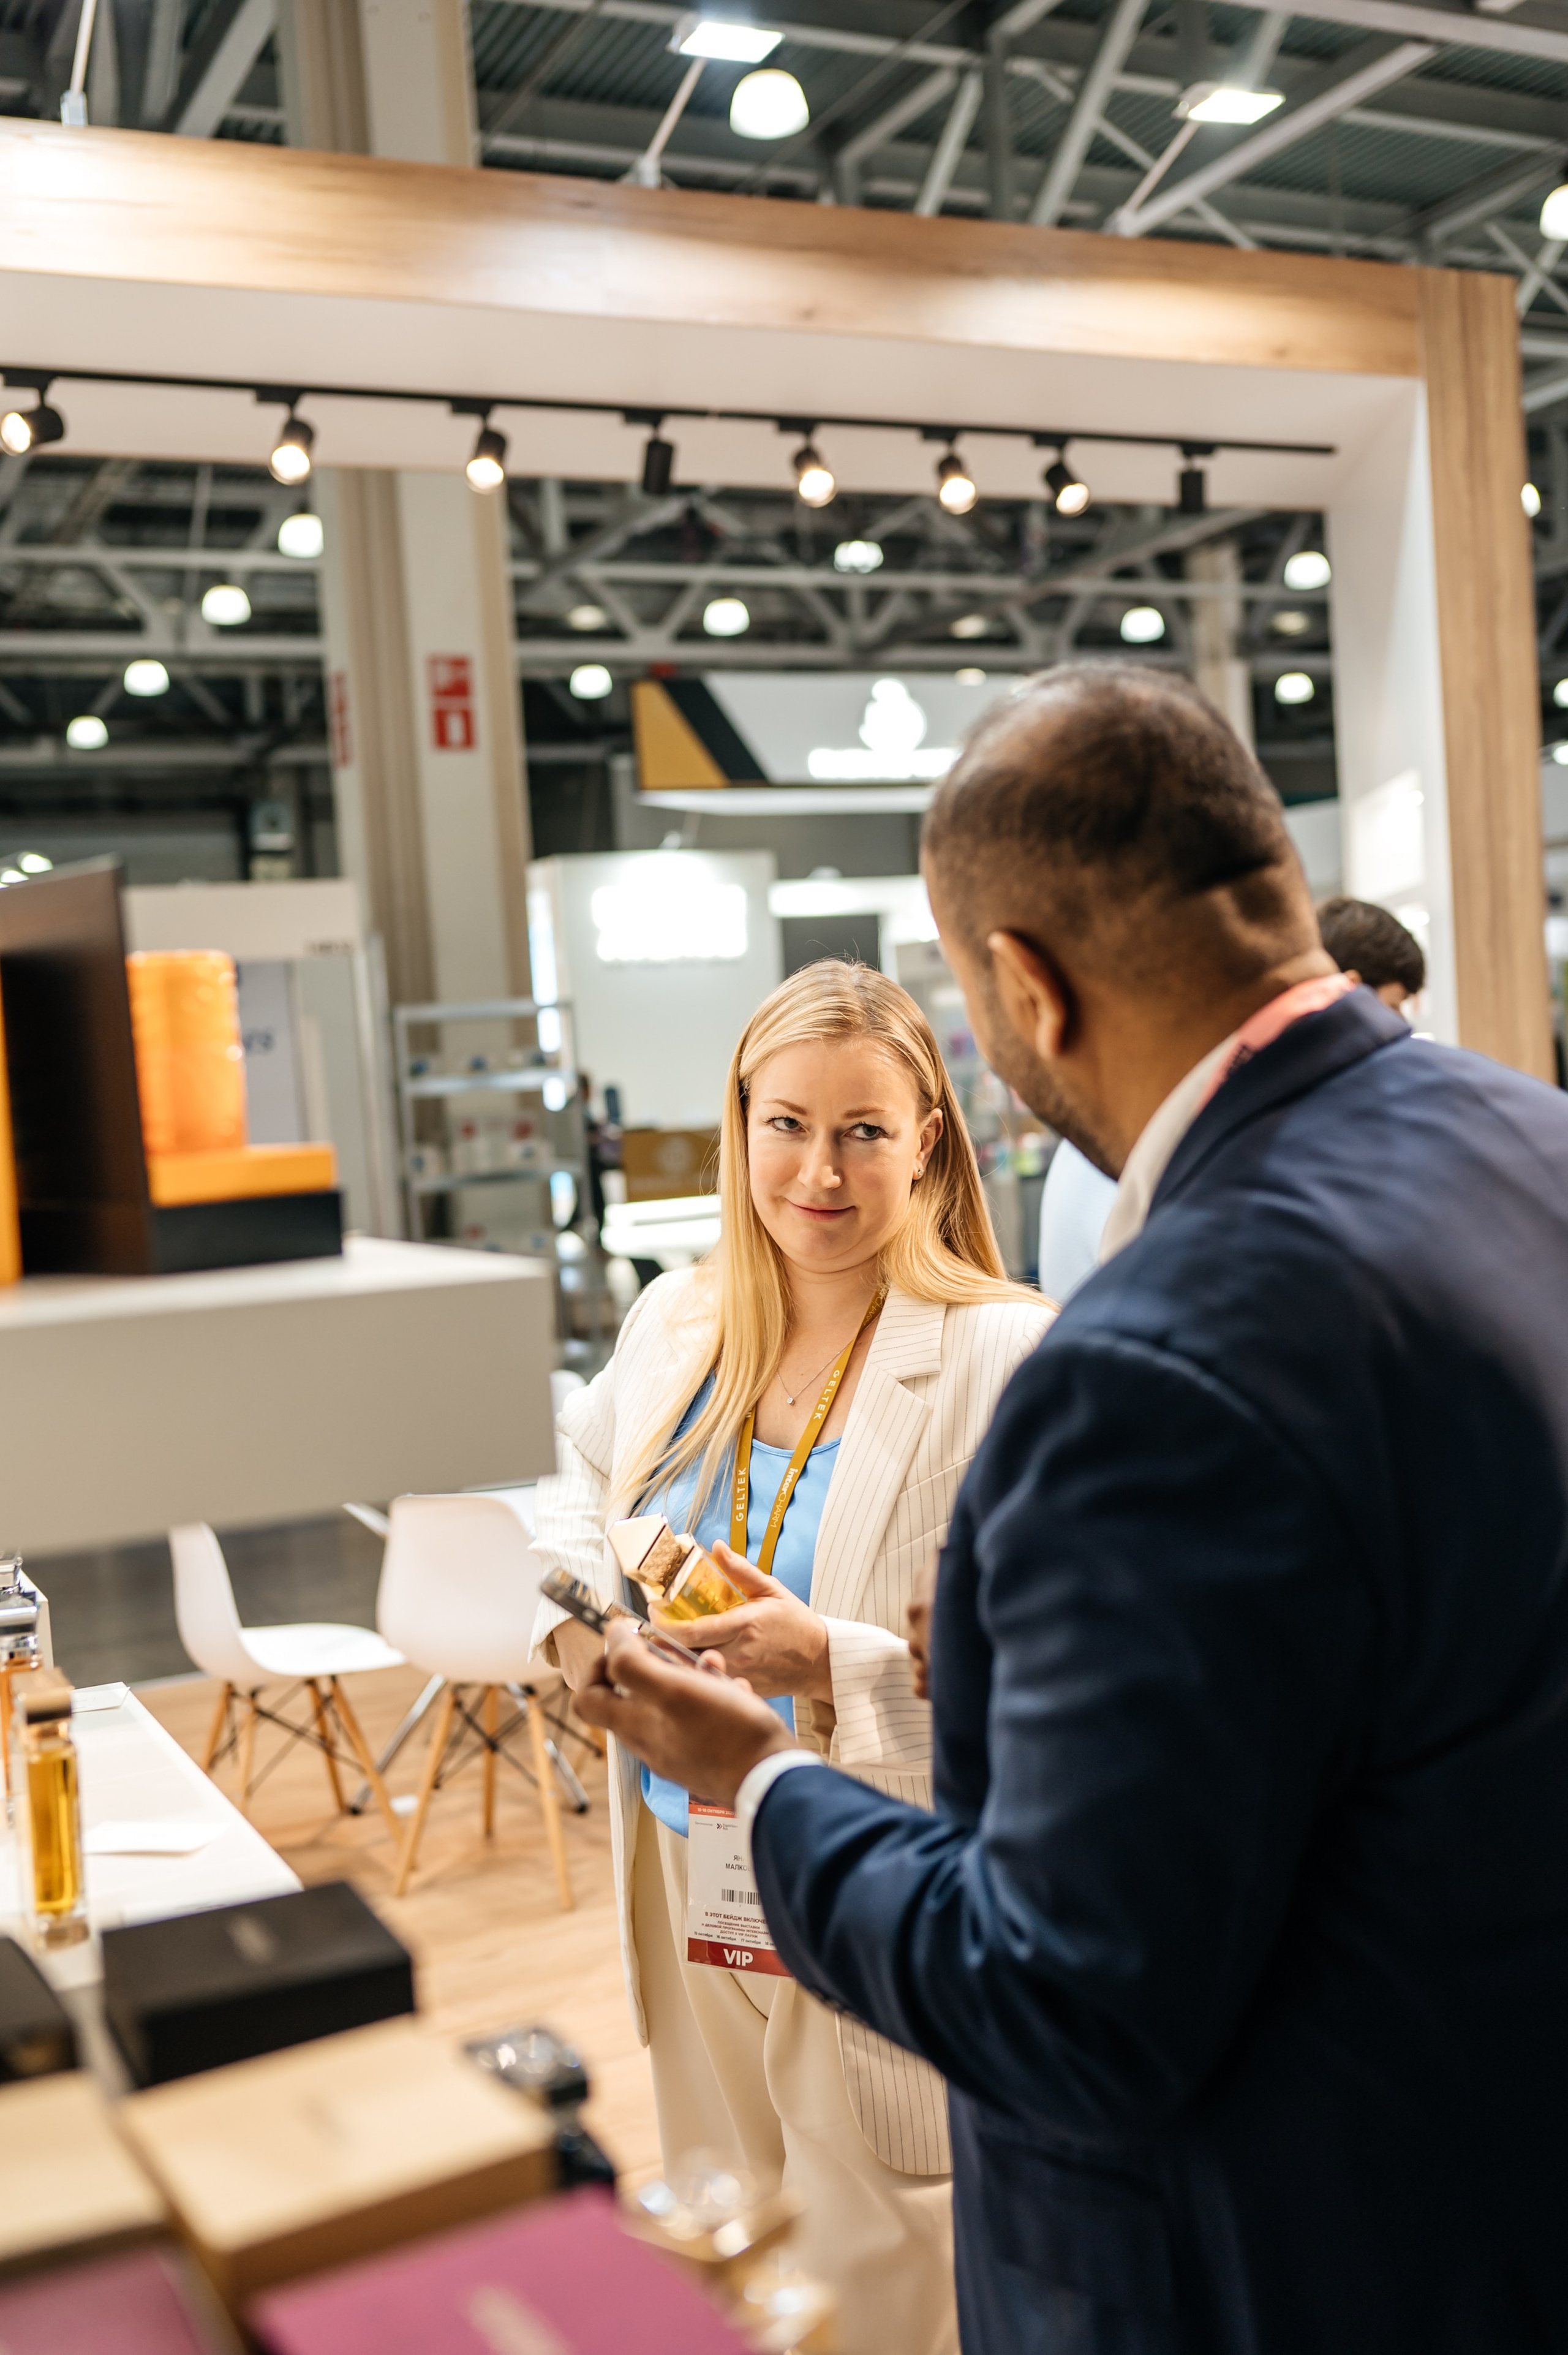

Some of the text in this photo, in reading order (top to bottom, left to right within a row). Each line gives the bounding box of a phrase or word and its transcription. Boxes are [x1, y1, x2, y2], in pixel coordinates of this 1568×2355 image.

[813, 1370, 840, 1419] GELTEK
[736, 1467, 746, 1522] GELTEK
[770, 1467, 798, 1528] interCHARM
[723, 1948, 753, 1967] VIP
